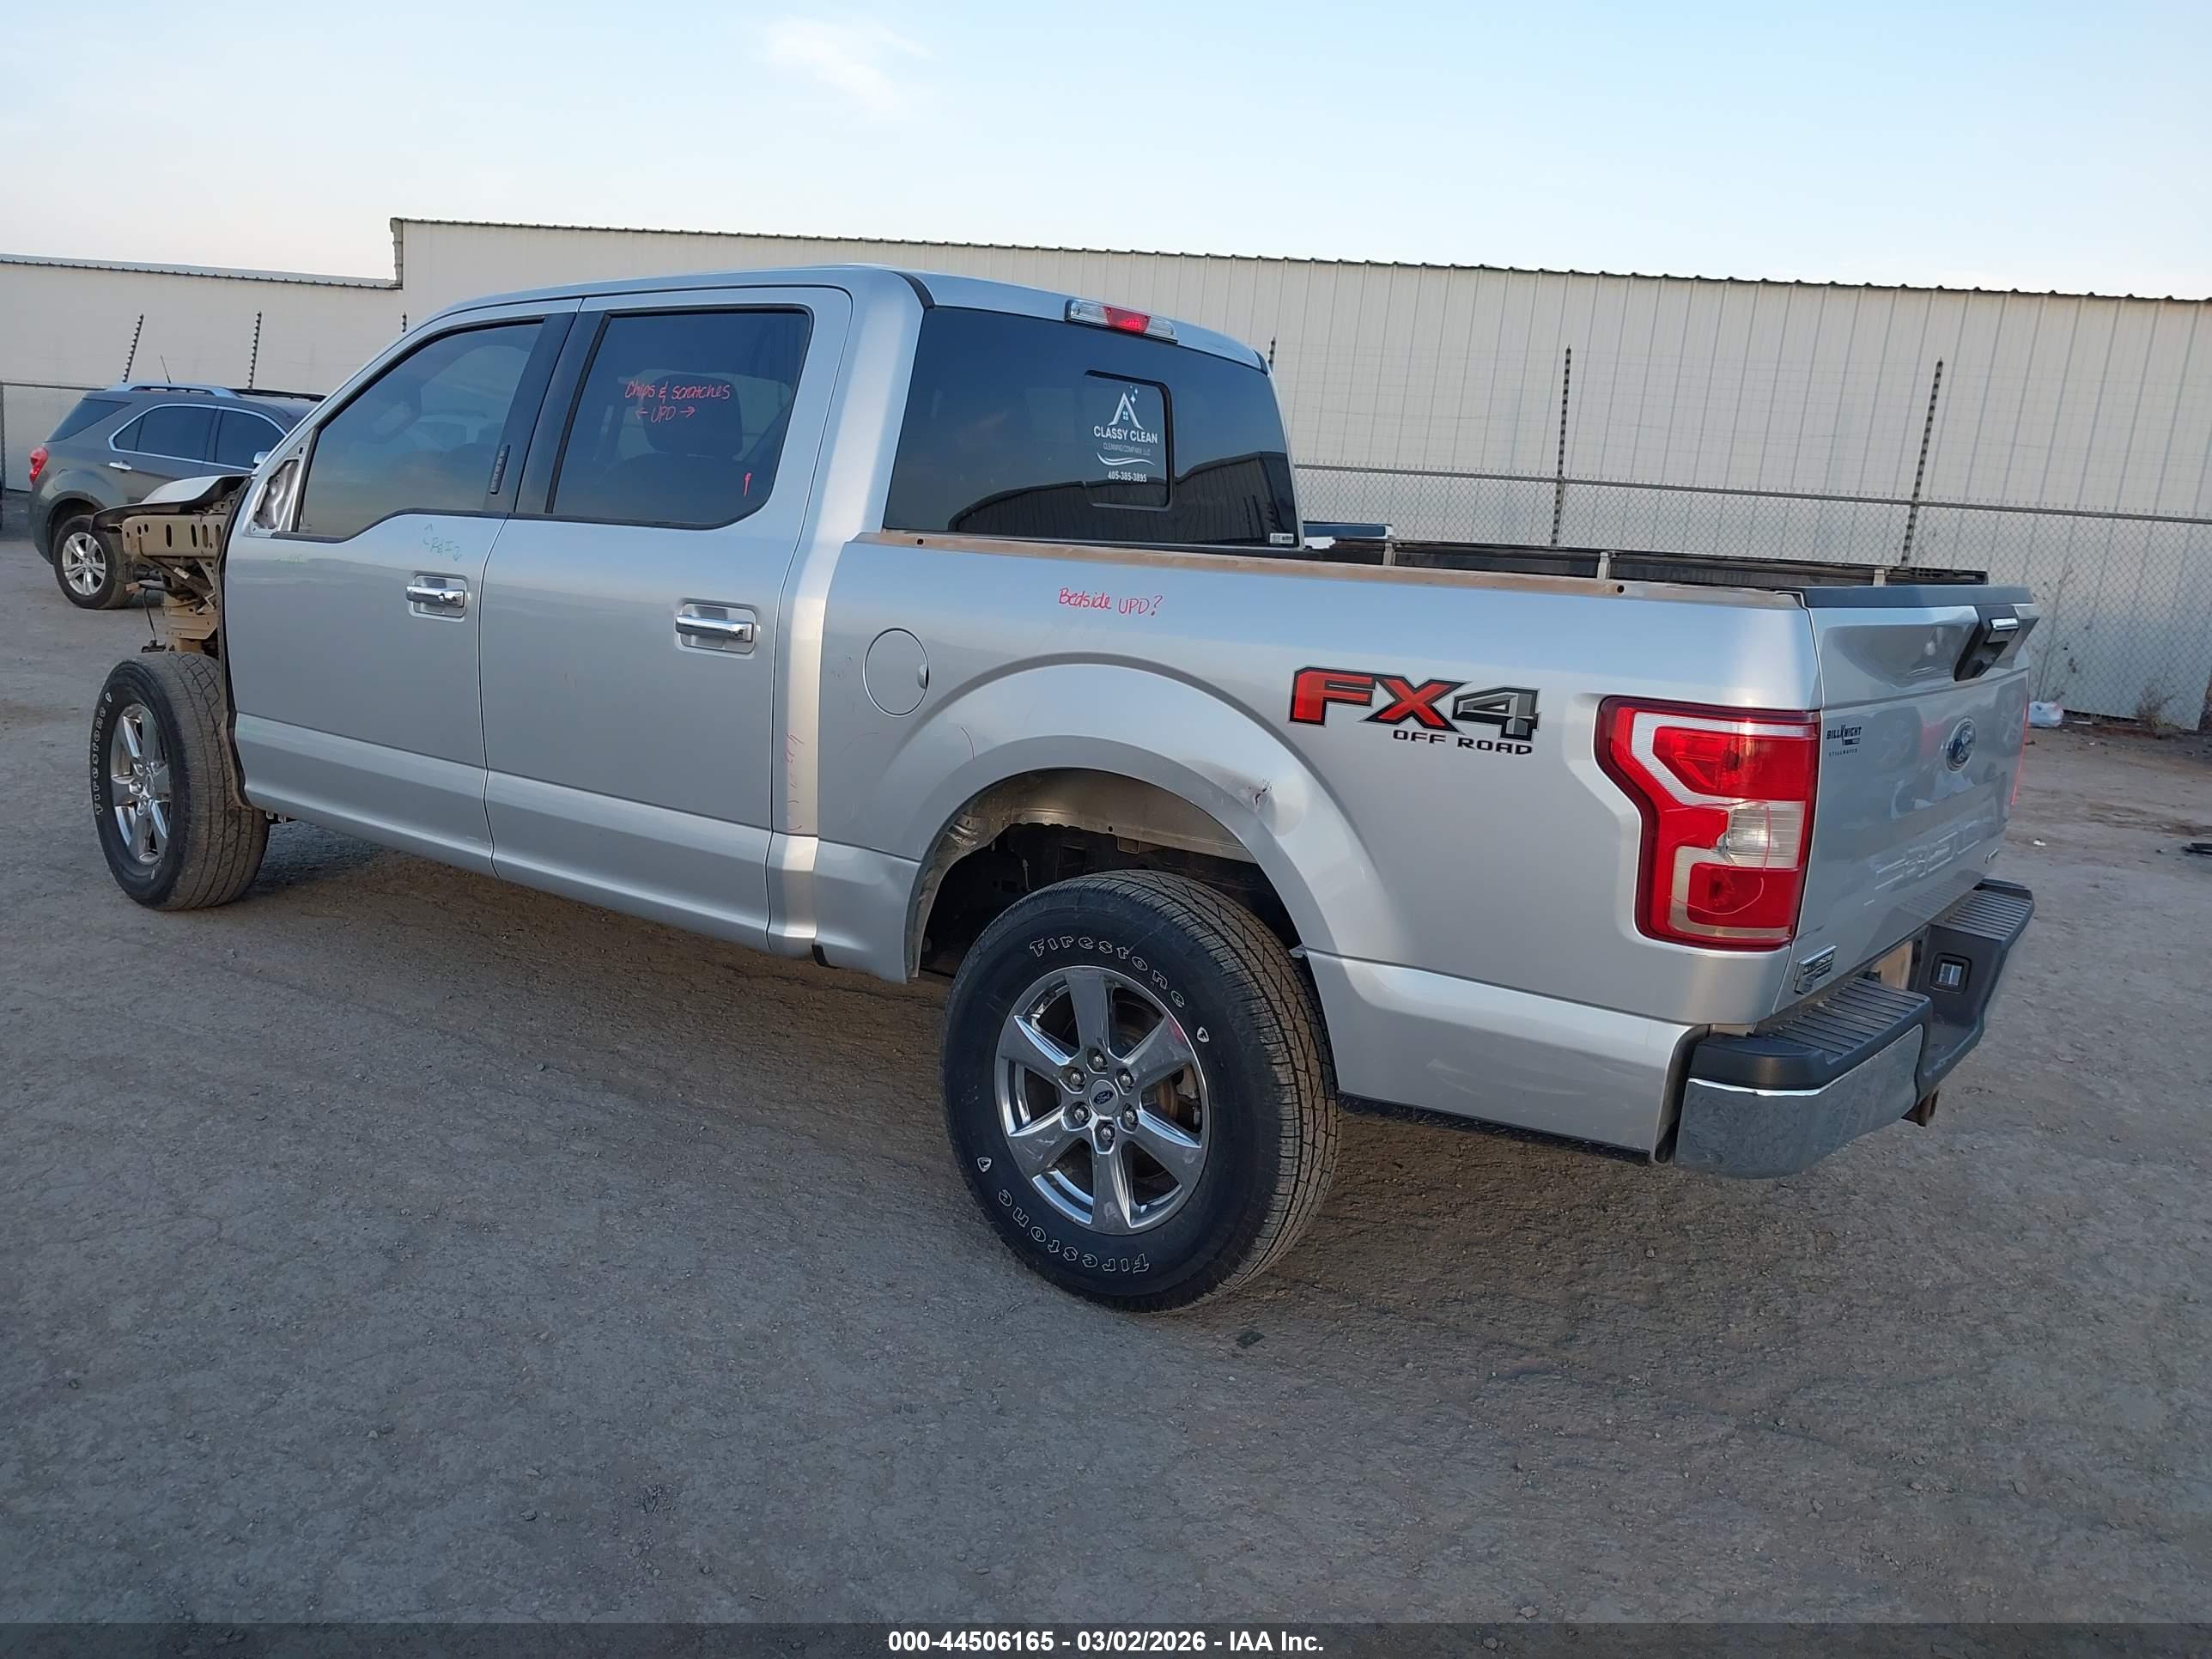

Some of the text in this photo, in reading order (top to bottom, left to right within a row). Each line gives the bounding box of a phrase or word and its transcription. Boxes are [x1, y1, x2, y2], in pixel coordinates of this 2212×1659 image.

[650, 404, 678, 423] UPD
[1093, 426, 1158, 444] CLASSY CLEAN
[1108, 471, 1147, 483] 405-385-3895
[1058, 586, 1164, 617] Bedside UPD?
[1288, 665, 1540, 743] FX4
[1392, 729, 1534, 757] OFF ROAD
[1029, 933, 1186, 1009] Firestone
[998, 1187, 1151, 1274] Firestone
